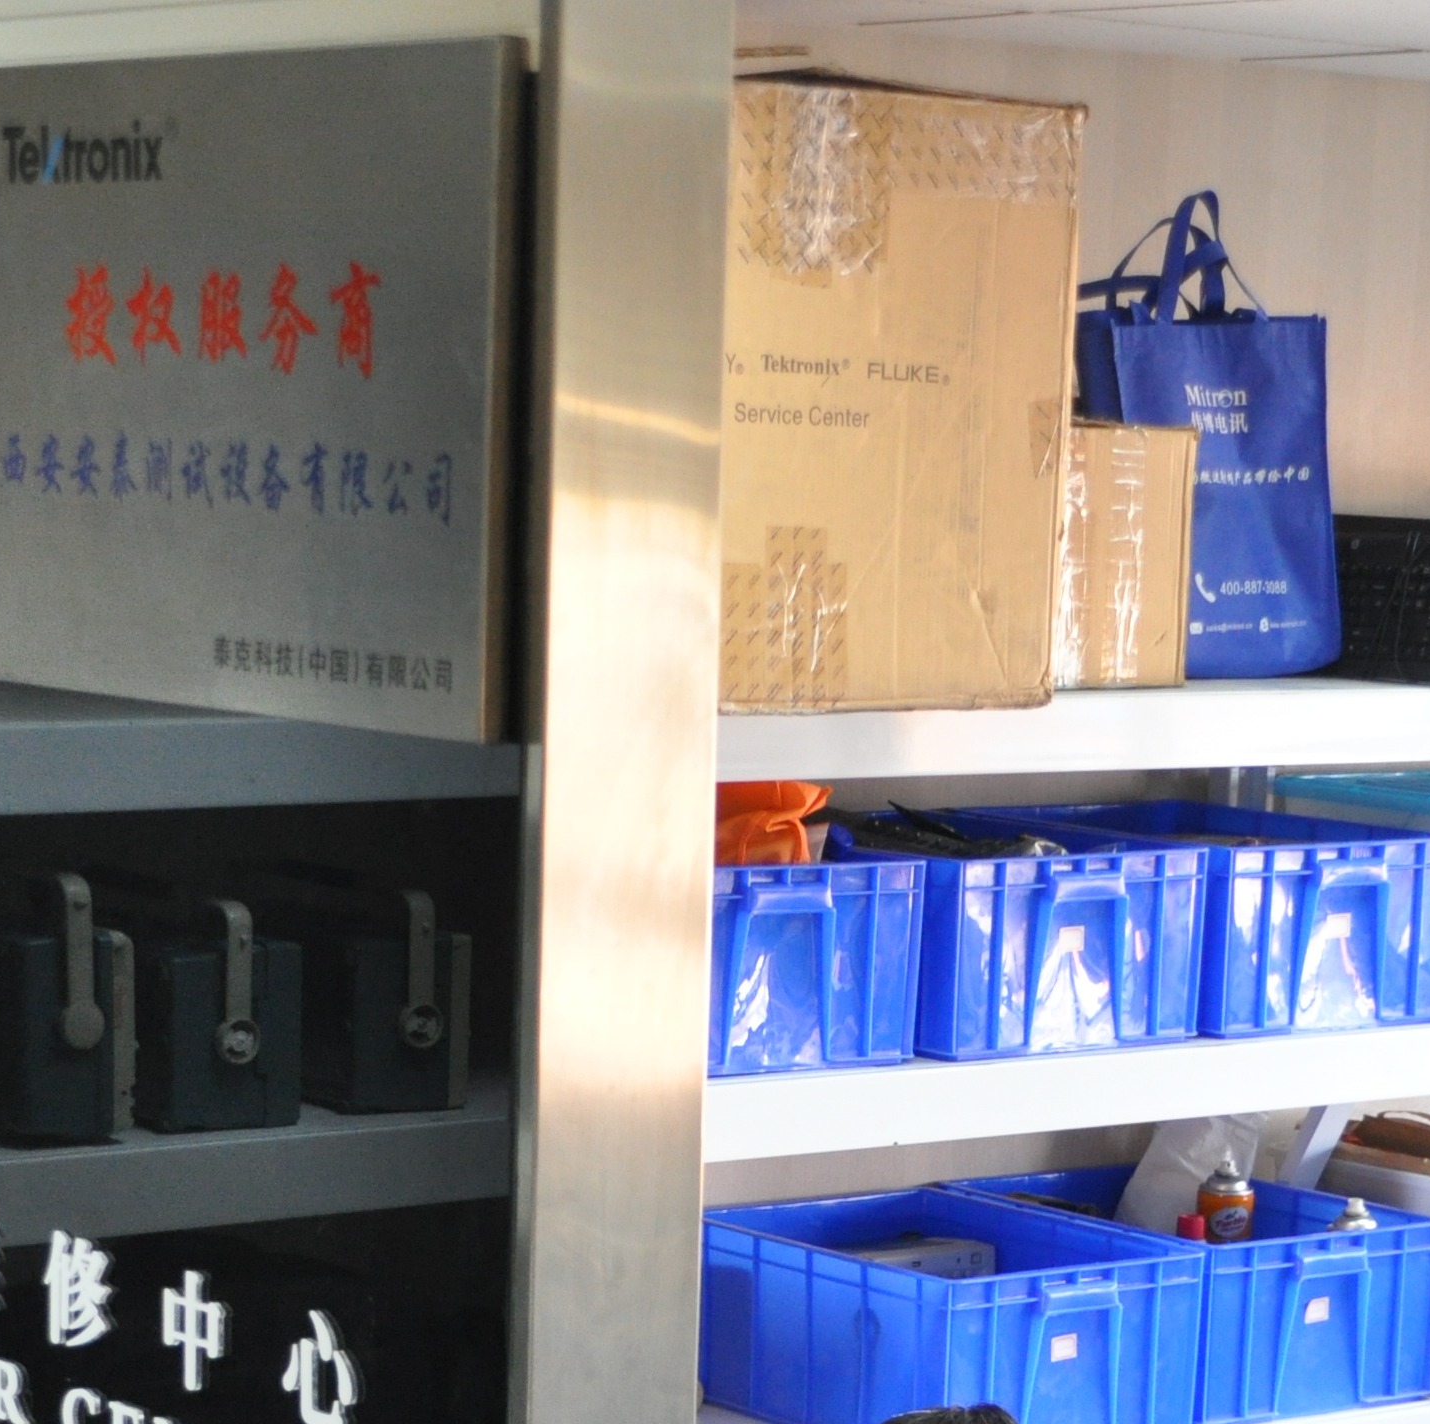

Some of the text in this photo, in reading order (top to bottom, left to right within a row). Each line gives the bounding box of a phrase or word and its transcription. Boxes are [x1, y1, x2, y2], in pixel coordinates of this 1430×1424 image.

[2, 119, 163, 184] Tektronix
[64, 259, 384, 380] 授权服务商
[734, 402, 870, 428] Service Center
[1184, 384, 1248, 408] Mitron
[0, 434, 453, 527] 西安安泰测试设备有限公司
[1219, 580, 1288, 596] 400-887-3088
